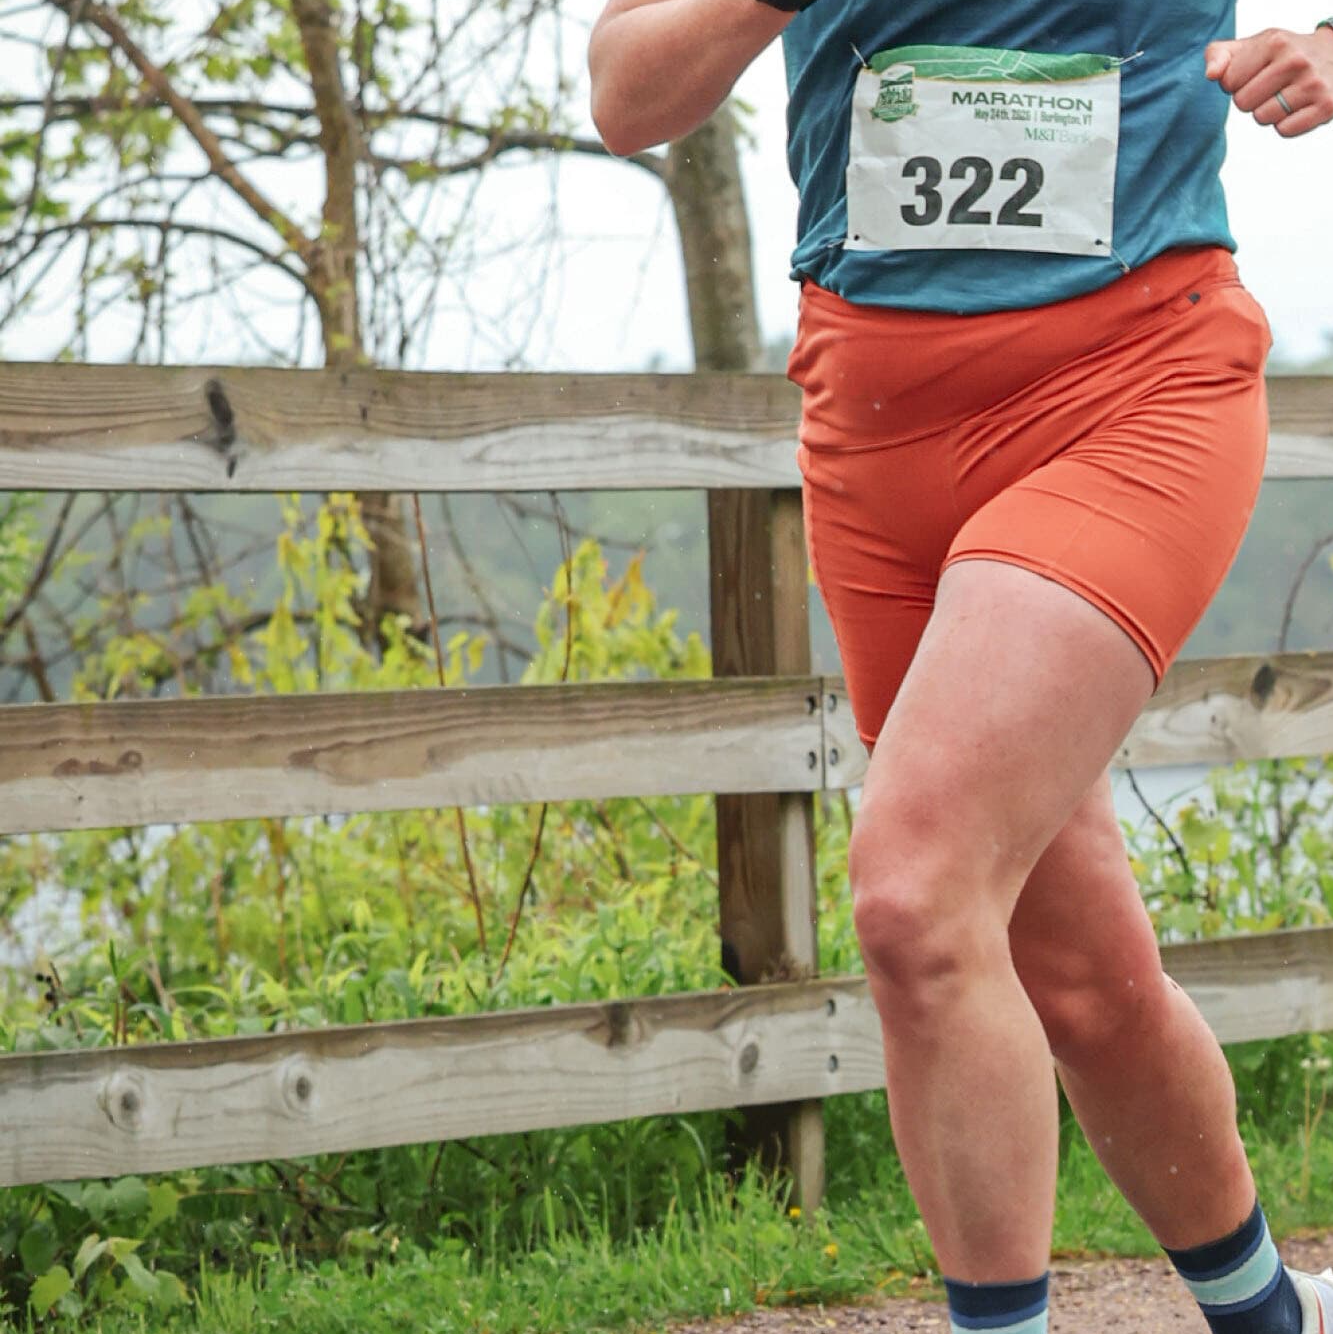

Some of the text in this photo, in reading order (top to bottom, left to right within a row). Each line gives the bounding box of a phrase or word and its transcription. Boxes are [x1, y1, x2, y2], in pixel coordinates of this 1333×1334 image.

[952, 91, 1092, 112] MARATHON
[974, 108, 988, 122] May
[1024, 127, 1089, 144] M&T Bank
[901, 157, 1043, 227] 322
